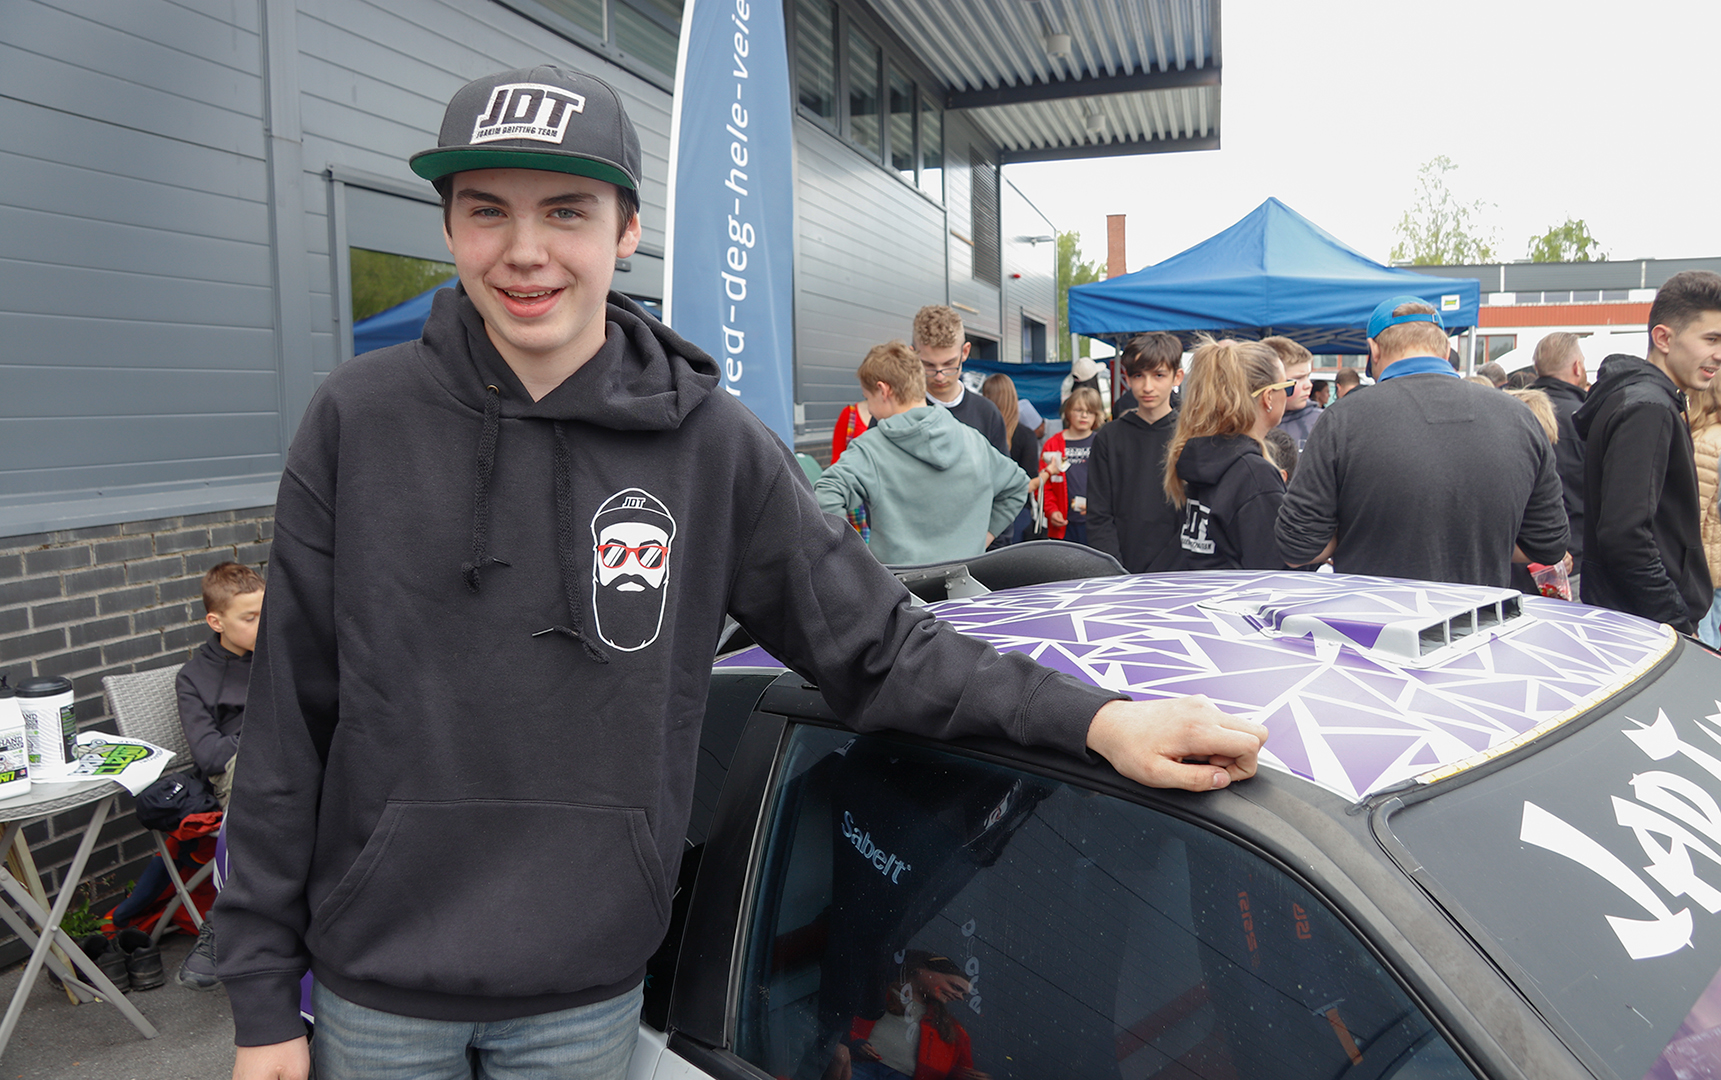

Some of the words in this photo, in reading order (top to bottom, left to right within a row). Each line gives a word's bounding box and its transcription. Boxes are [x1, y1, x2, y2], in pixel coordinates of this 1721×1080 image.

[479, 88, 580, 129] JDT
[476, 126, 501, 139] JOAKIM
[502, 125, 537, 135] DRIFTING
[538, 127, 559, 138] TEAM
[623, 497, 645, 508] JDT
[841, 810, 907, 885] Sabelt
